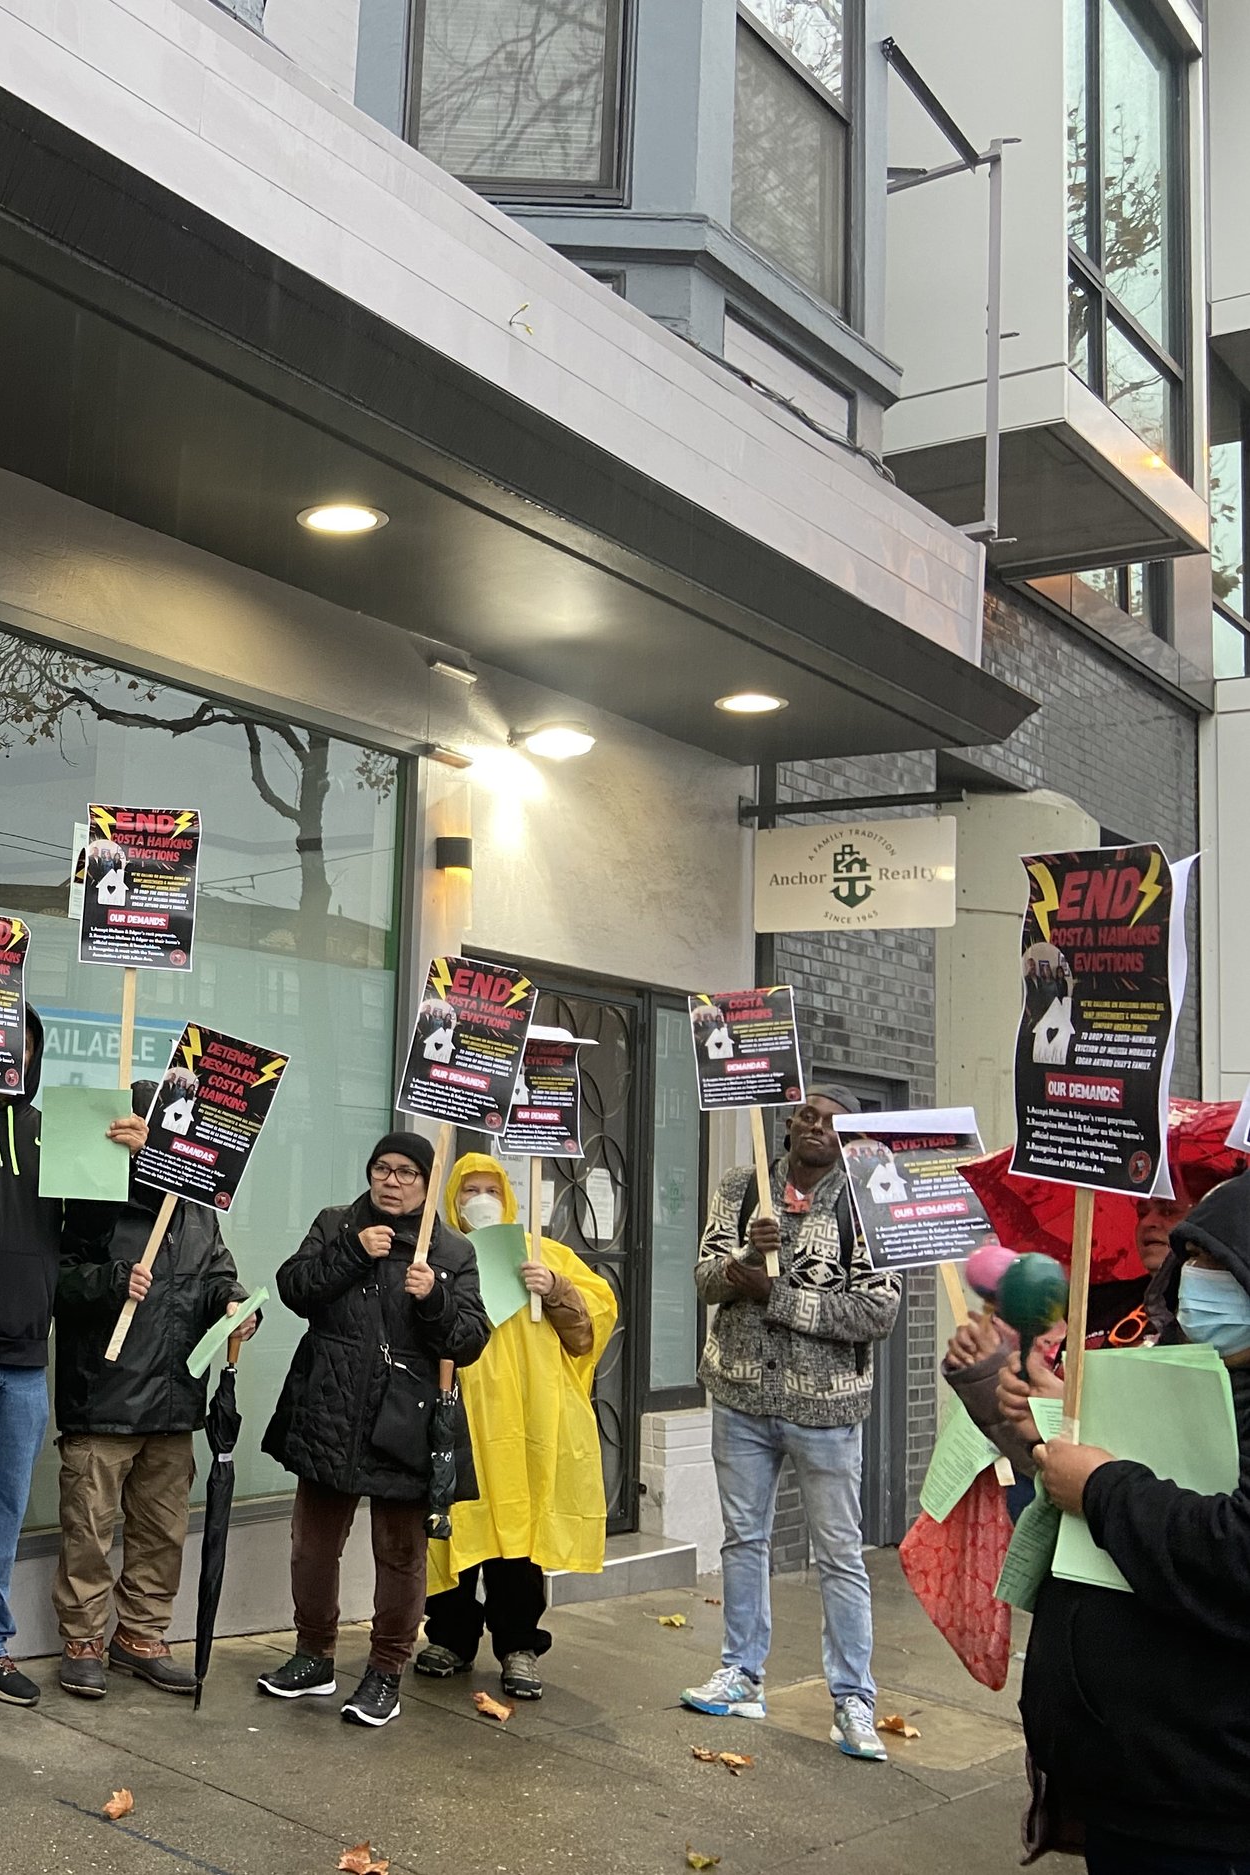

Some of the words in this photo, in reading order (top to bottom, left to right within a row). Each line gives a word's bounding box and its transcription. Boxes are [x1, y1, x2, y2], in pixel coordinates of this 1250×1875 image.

[115, 812, 175, 833] END
[111, 833, 143, 846] COSTA
[147, 835, 193, 850] HAWKINS
[813, 831, 844, 853] FAMILY
[849, 829, 897, 857] TRADITION
[129, 848, 180, 863] EVICTIONS
[769, 872, 827, 887] Anchor
[878, 865, 937, 882] Realty
[1057, 866, 1143, 921] END
[110, 913, 125, 923] OUR
[823, 910, 851, 924] SINCE
[1050, 926, 1093, 948] COSTA
[1097, 924, 1160, 947] HAWKINS
[1073, 952, 1144, 974] EVICTIONS
[451, 968, 512, 1002] END
[446, 994, 478, 1010] COSTA
[479, 1000, 525, 1021] HAWKINS
[729, 997, 764, 1008] COSTA
[460, 1010, 511, 1030] EVICTIONS
[44, 1027, 155, 1062] AILABE
[1081, 1032, 1088, 1040] TO
[1103, 1033, 1113, 1041] THE
[207, 1041, 257, 1069] DETENGA
[526, 1056, 564, 1066] EVICTIONS
[200, 1056, 260, 1085] DESALOJOS
[432, 1068, 447, 1080] OUR
[209, 1074, 244, 1097] COSTA
[1048, 1081, 1068, 1098] OUR
[199, 1085, 248, 1113] HAWKINS
[518, 1111, 530, 1120] OUR
[1068, 1110, 1073, 1118] &
[1094, 1115, 1106, 1123] rent
[1107, 1115, 1137, 1128] payments.
[1078, 1123, 1082, 1132] &
[1109, 1127, 1121, 1137] their
[892, 1136, 957, 1151] EVICTIONS
[1058, 1146, 1062, 1154] &
[1077, 1148, 1089, 1158] with
[1089, 1150, 1098, 1159] the
[1029, 1154, 1058, 1166] Association
[1060, 1158, 1066, 1167] of
[1066, 1159, 1075, 1168] 140
[1076, 1161, 1091, 1171] Julian
[894, 1208, 913, 1218] OUR
